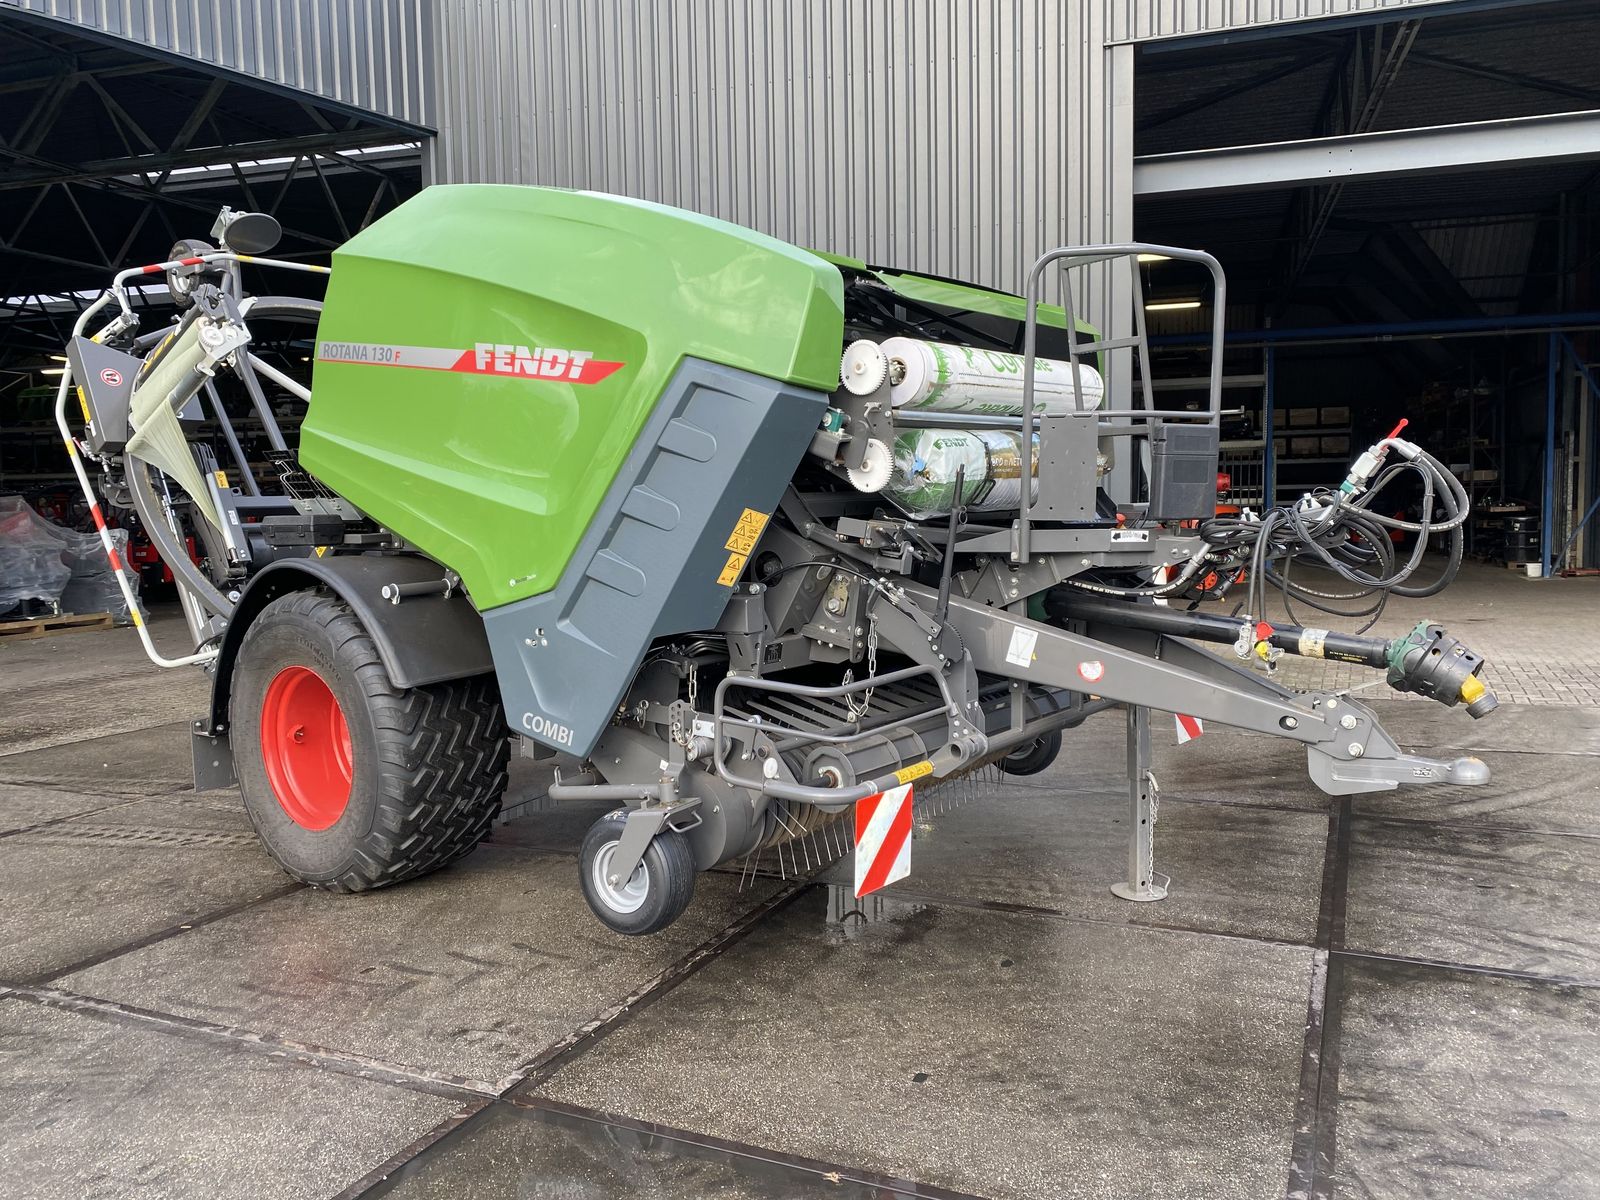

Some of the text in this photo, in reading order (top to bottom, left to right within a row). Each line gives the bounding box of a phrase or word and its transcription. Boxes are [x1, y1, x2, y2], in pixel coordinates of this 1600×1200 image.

[323, 343, 401, 362] ROTANA 130 F
[474, 342, 594, 379] FENDT
[522, 712, 575, 747] COMBI
